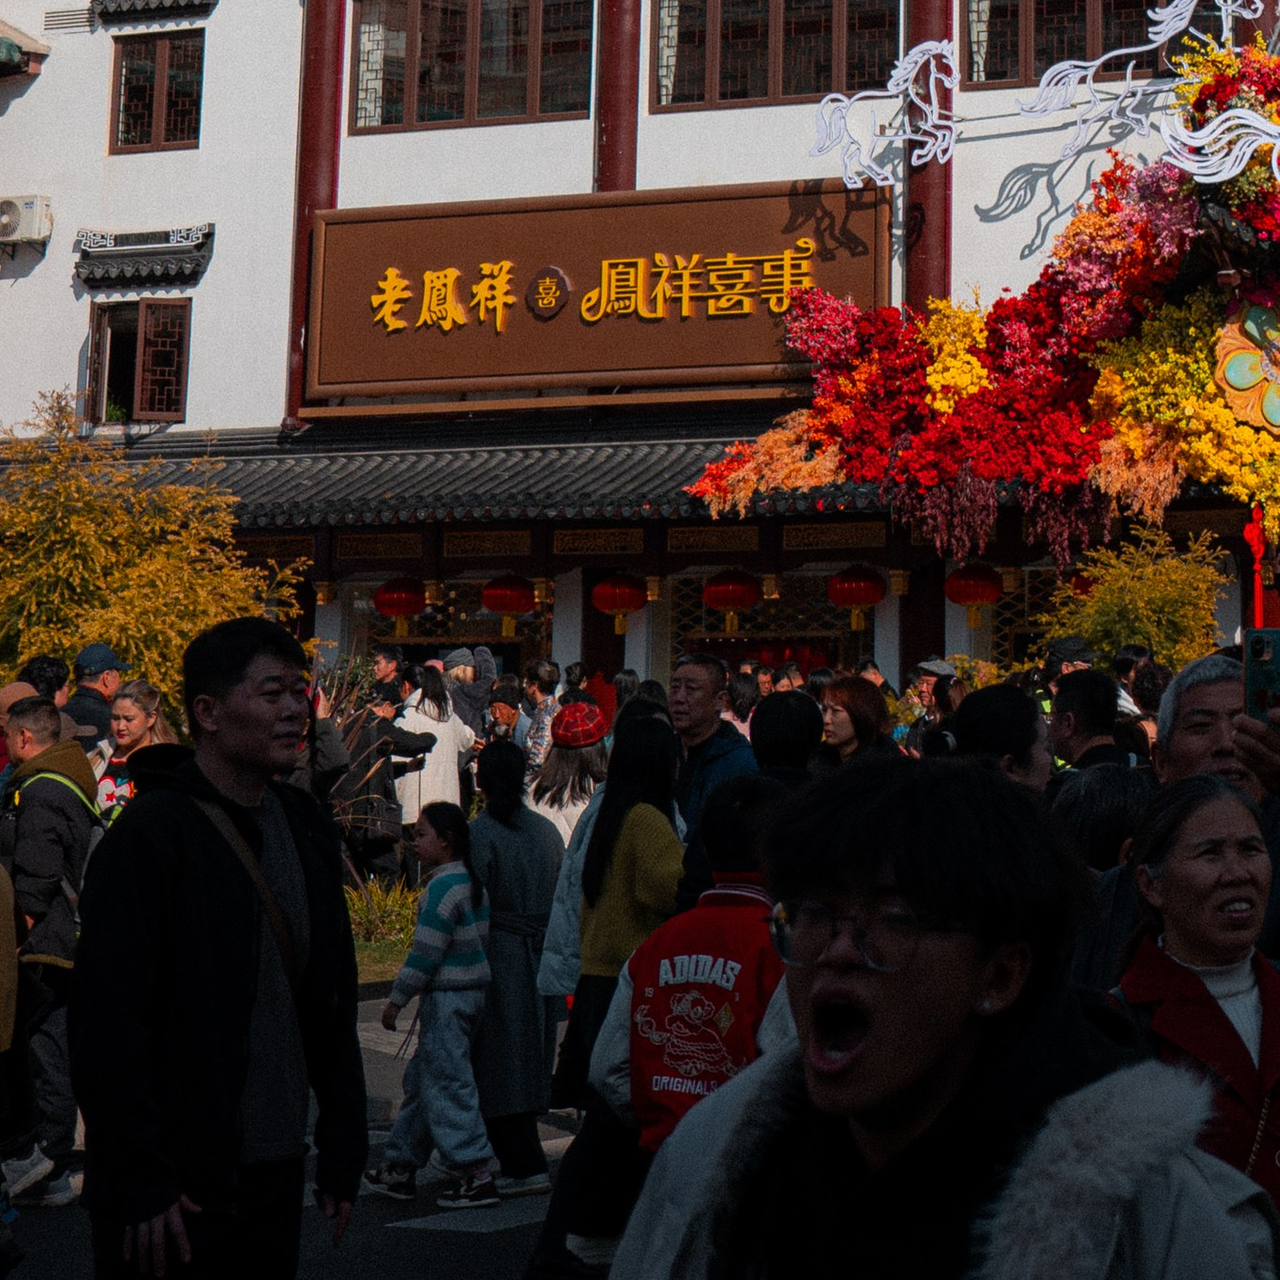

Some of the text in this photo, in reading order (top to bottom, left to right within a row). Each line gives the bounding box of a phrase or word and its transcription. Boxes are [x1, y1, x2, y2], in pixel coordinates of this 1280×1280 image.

[371, 260, 516, 332] 老鳳祥
[658, 954, 742, 991] ADIDAS
